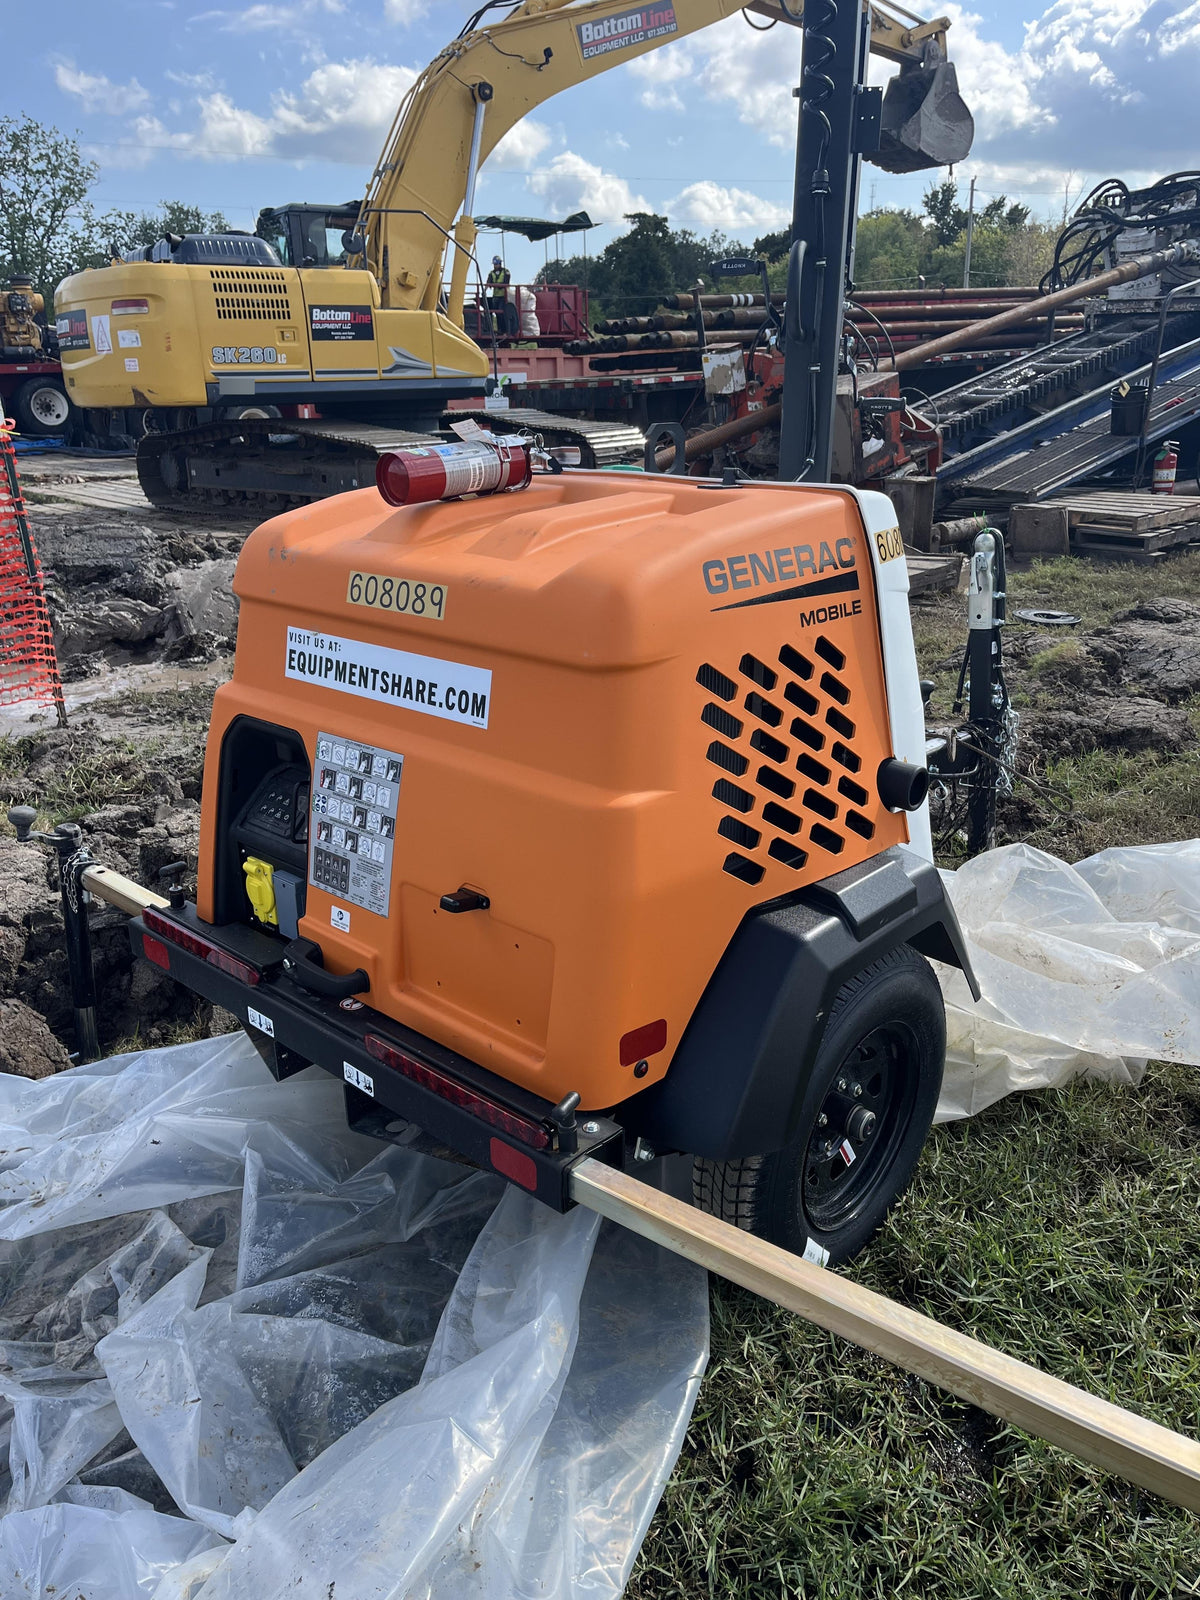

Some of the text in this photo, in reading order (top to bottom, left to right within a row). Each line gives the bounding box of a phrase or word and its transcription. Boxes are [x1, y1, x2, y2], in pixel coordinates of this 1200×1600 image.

[583, 36, 630, 57] EQUIPMENT
[631, 32, 645, 43] LLC
[277, 353, 287, 364] LC
[350, 573, 444, 618] 608089
[800, 600, 862, 628] MOBILE
[289, 631, 342, 652] VISIT US AT:
[288, 648, 487, 719] EQUIPMENTSHARE.COM
